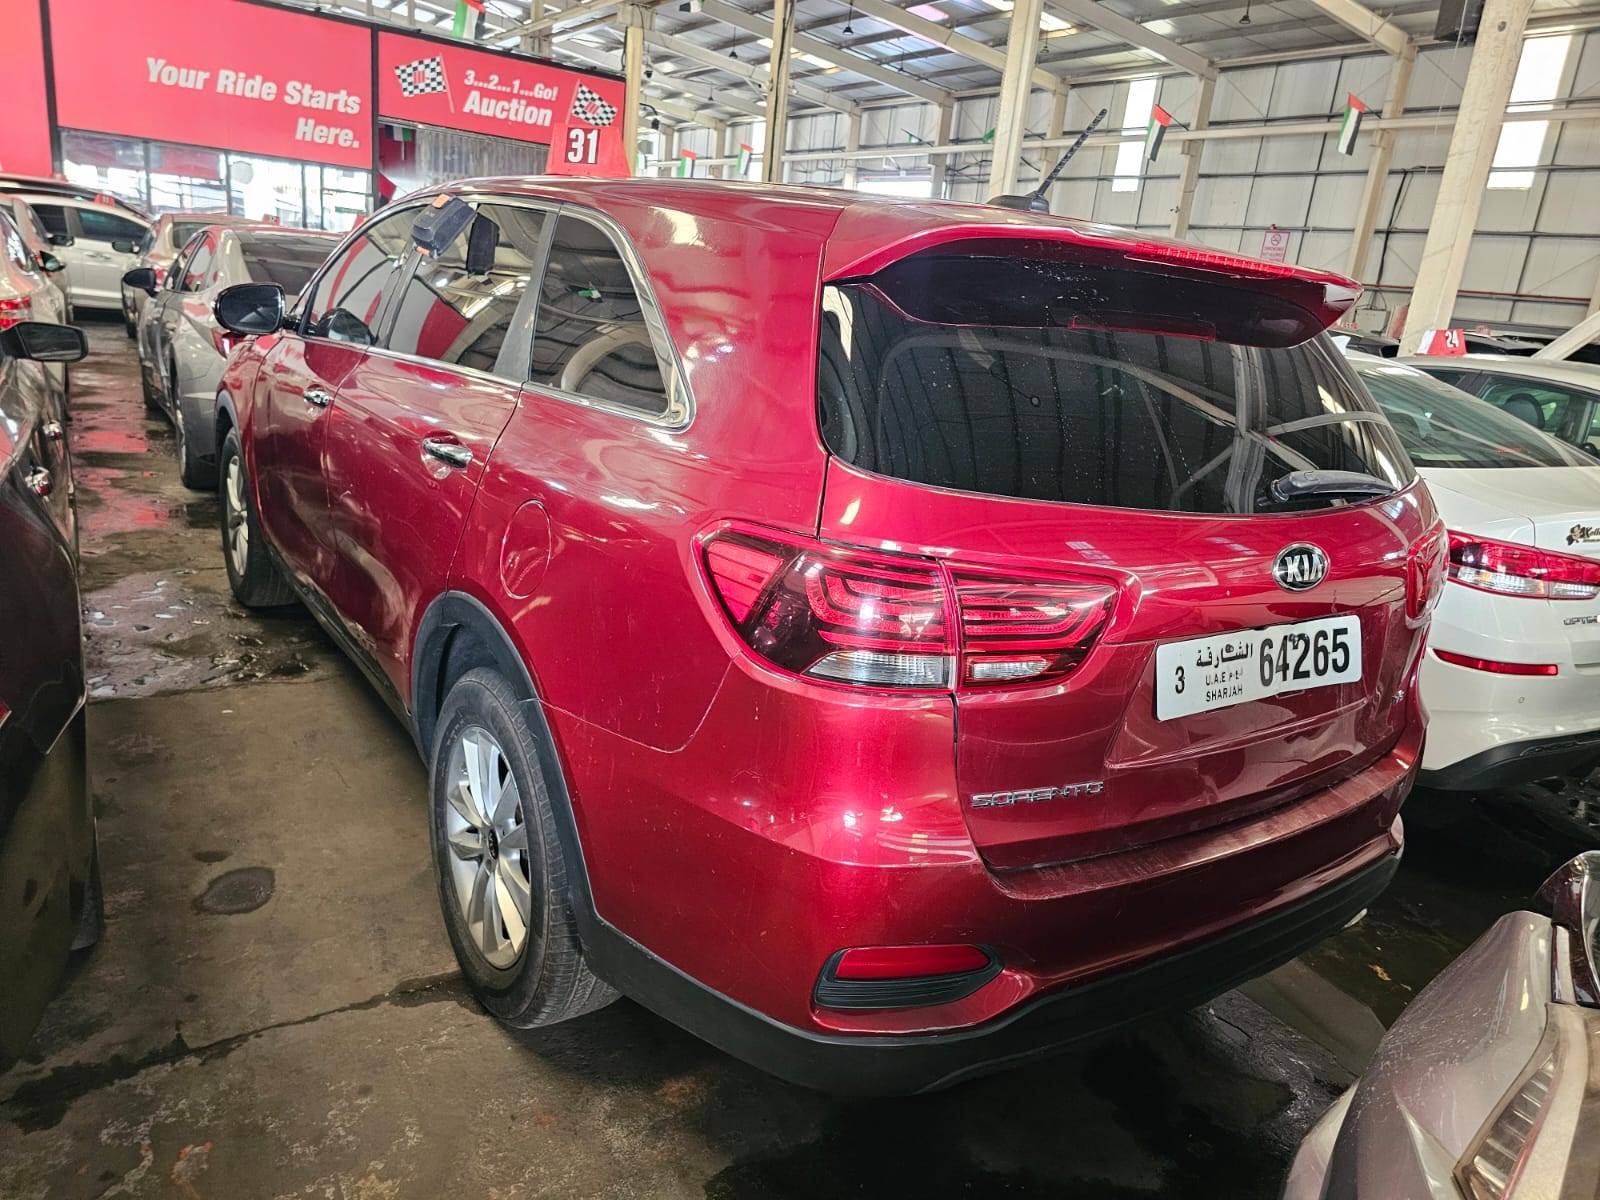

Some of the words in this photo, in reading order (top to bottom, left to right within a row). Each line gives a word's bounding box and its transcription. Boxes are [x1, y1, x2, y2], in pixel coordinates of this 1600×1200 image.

[146, 57, 210, 90] Your
[216, 68, 277, 102] Ride
[284, 80, 361, 115] Starts
[463, 90, 553, 127] Auction
[295, 117, 360, 149] Here.
[567, 128, 597, 164] 31
[1445, 330, 1459, 348] 24
[1284, 553, 1323, 583] KIA
[1196, 641, 1253, 669] الشارقة
[1259, 627, 1350, 687] 64265
[1175, 666, 1185, 694] 3
[1205, 684, 1243, 702] SHARJAH
[972, 780, 1104, 808] SORENTO
